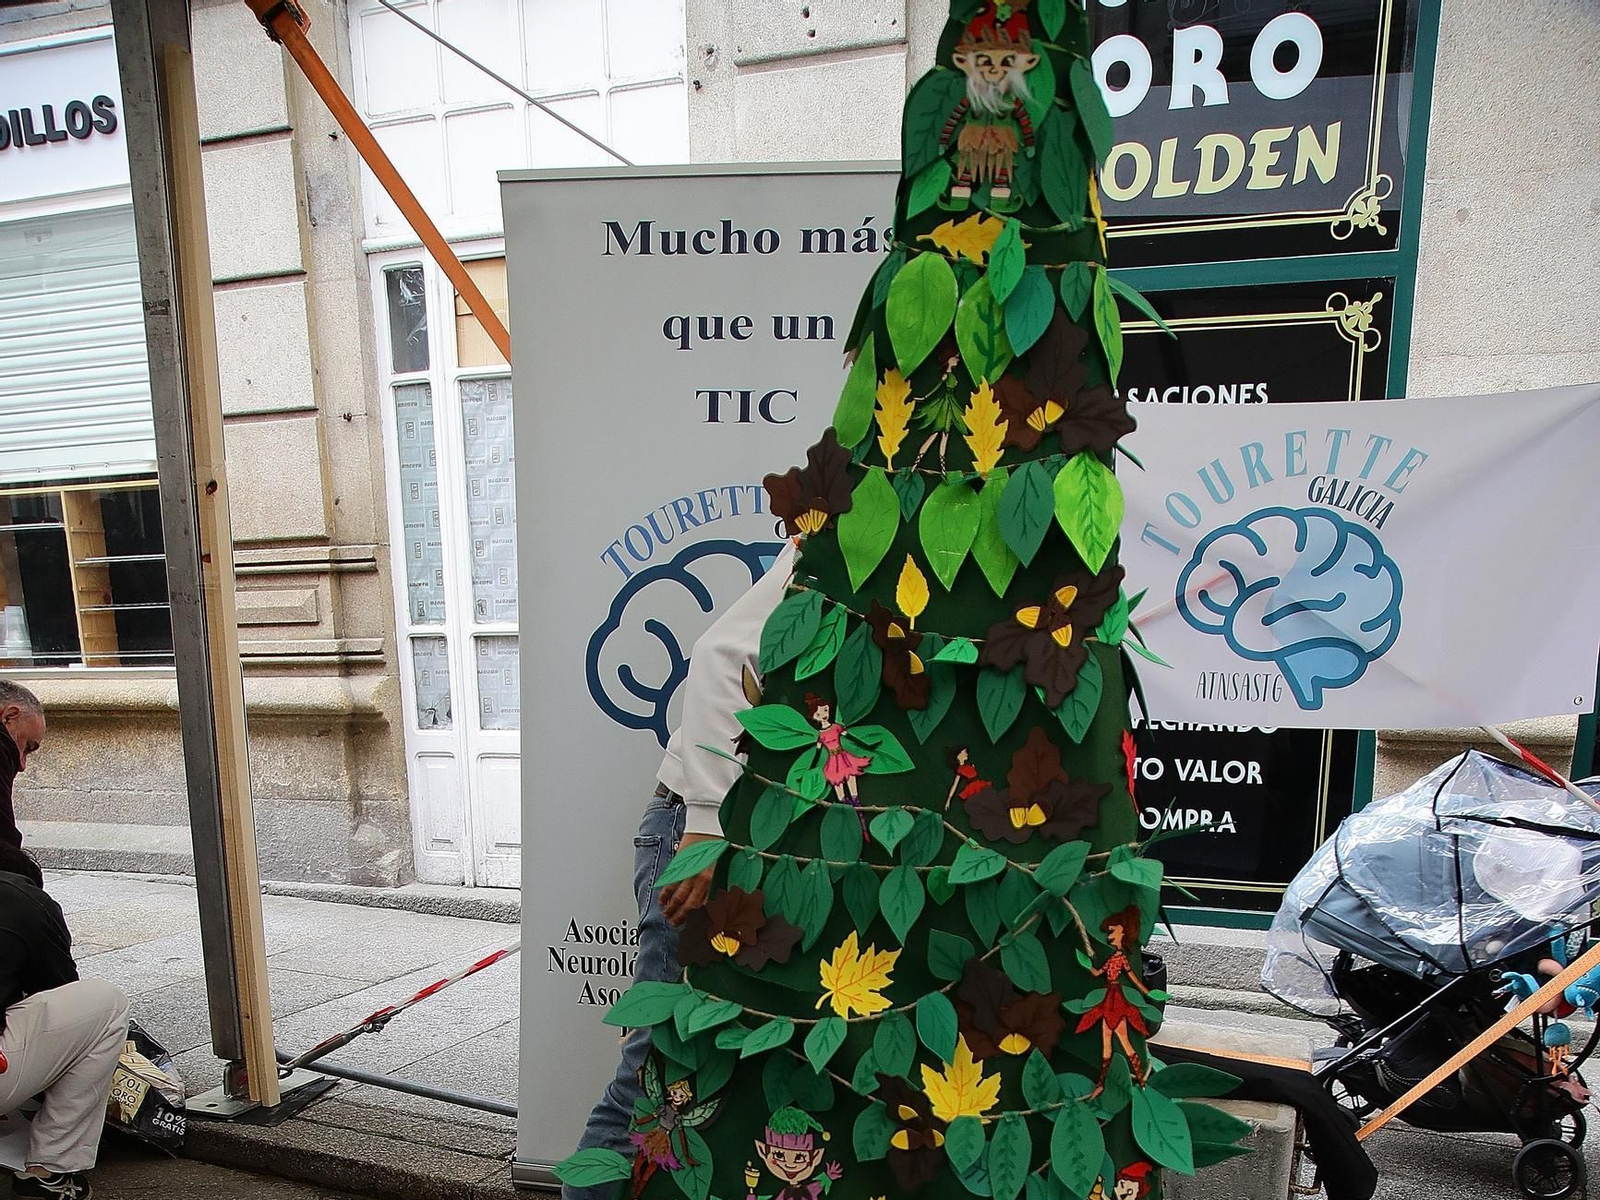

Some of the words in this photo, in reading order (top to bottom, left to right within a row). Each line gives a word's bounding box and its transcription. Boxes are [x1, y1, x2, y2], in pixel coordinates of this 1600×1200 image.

[1091, 12, 1323, 117] ORO
[1100, 121, 1342, 201] OLDEN
[602, 219, 780, 257] Mucho
[662, 312, 754, 351] que
[772, 313, 836, 341] un
[695, 389, 799, 425] TIC
[1127, 382, 1269, 405] SACIONES
[1140, 428, 1429, 556] TOURETTE
[1308, 476, 1395, 531] GALICIA
[600, 483, 766, 582] TOURETT
[1196, 671, 1283, 703] ATNSASTG
[1174, 758, 1263, 785] VALOR
[1139, 806, 1237, 834] OMPRA
[577, 980, 629, 1007] Aso
[112, 1087, 137, 1104] ORO
[152, 1118, 186, 1136] GRATIS
[156, 1106, 187, 1128] 10%
